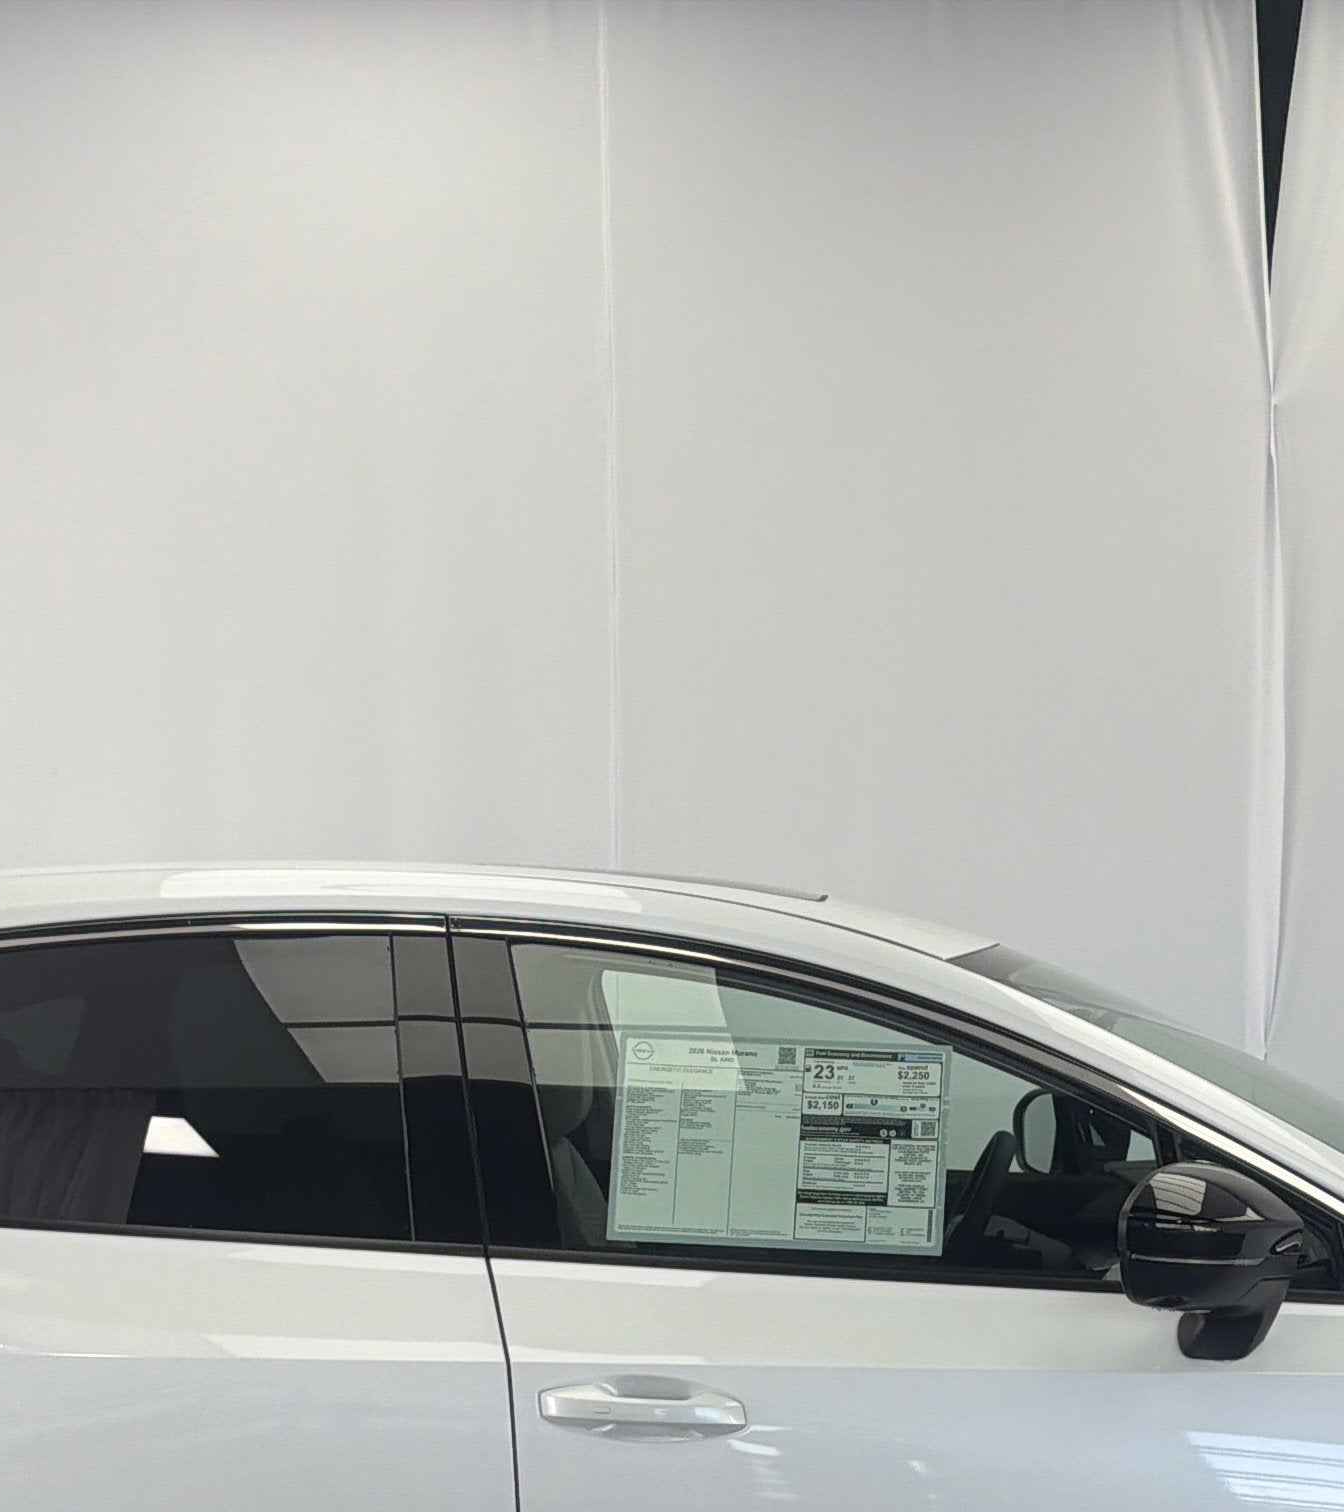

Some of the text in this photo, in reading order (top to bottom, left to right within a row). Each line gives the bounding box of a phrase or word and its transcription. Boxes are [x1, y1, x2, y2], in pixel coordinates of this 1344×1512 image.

[731, 1049, 758, 1057] Murano
[813, 1064, 835, 1080] 23
[897, 1070, 930, 1080] $2,250
[807, 1100, 839, 1111] $2,150
